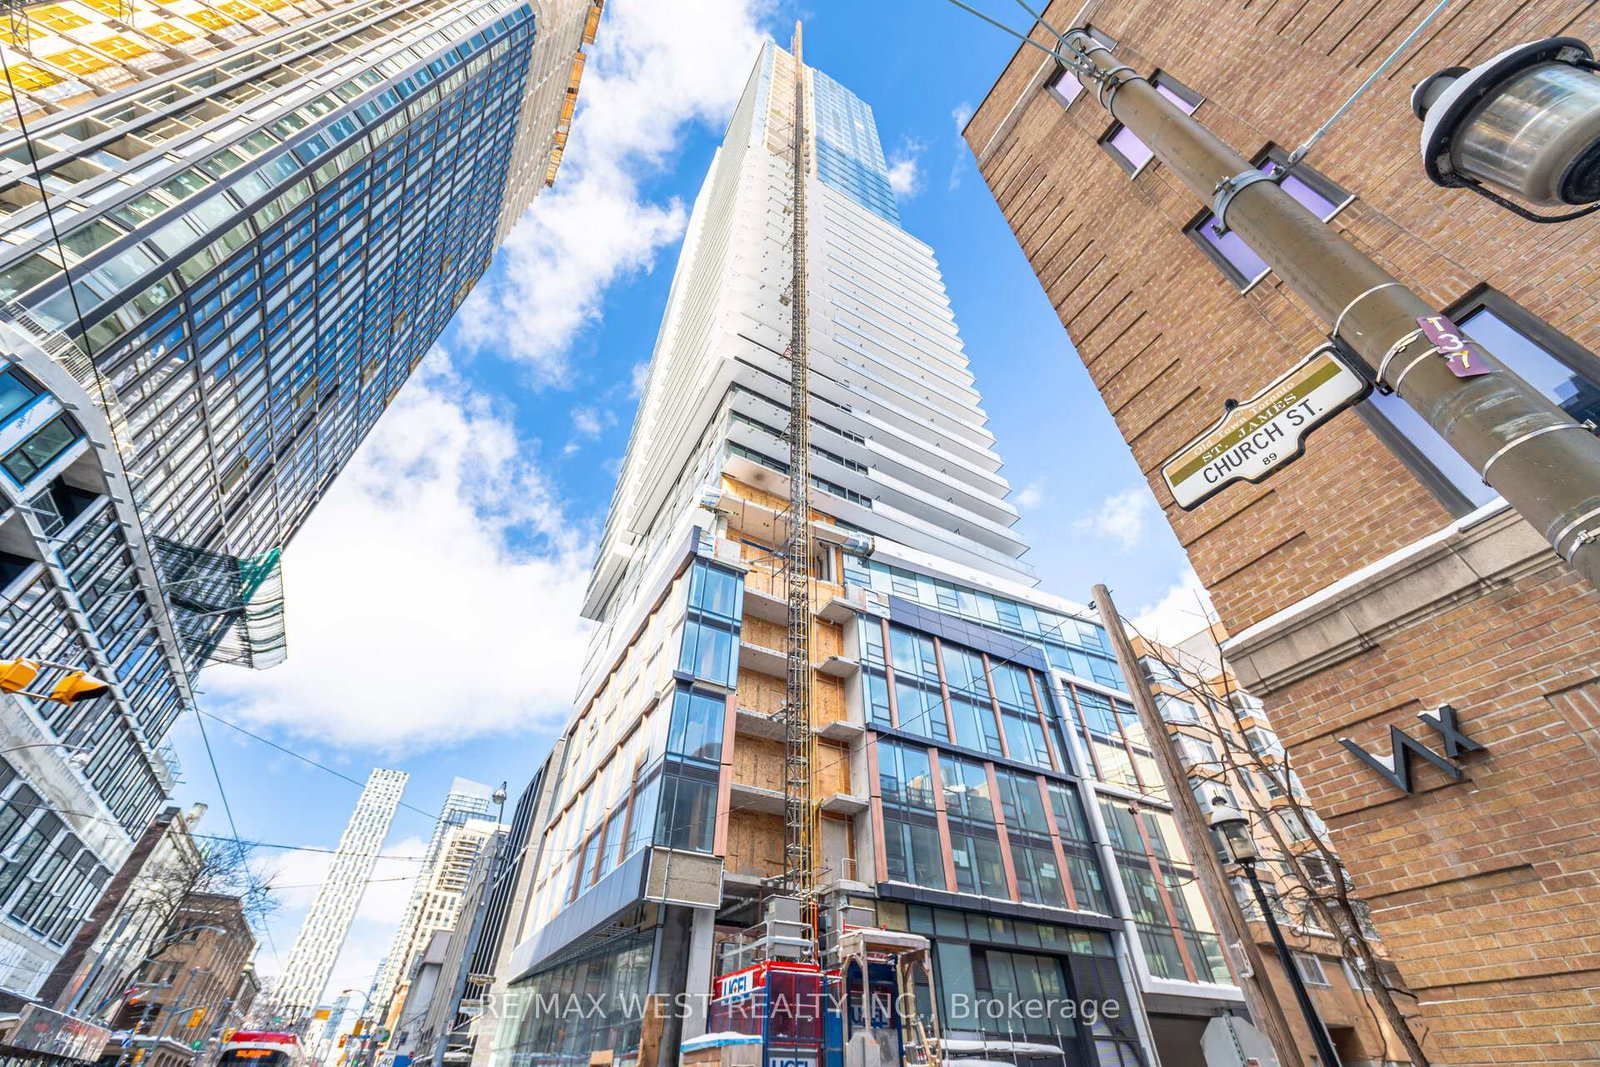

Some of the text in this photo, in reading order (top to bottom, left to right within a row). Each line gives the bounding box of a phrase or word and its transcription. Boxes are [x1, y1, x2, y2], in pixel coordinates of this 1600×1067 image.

[1193, 383, 1294, 456] Old Town Toronto
[1202, 443, 1229, 462] ST.
[1238, 393, 1297, 438] JAMES
[1203, 399, 1323, 484] CHURCH ST.
[1262, 452, 1278, 466] 89
